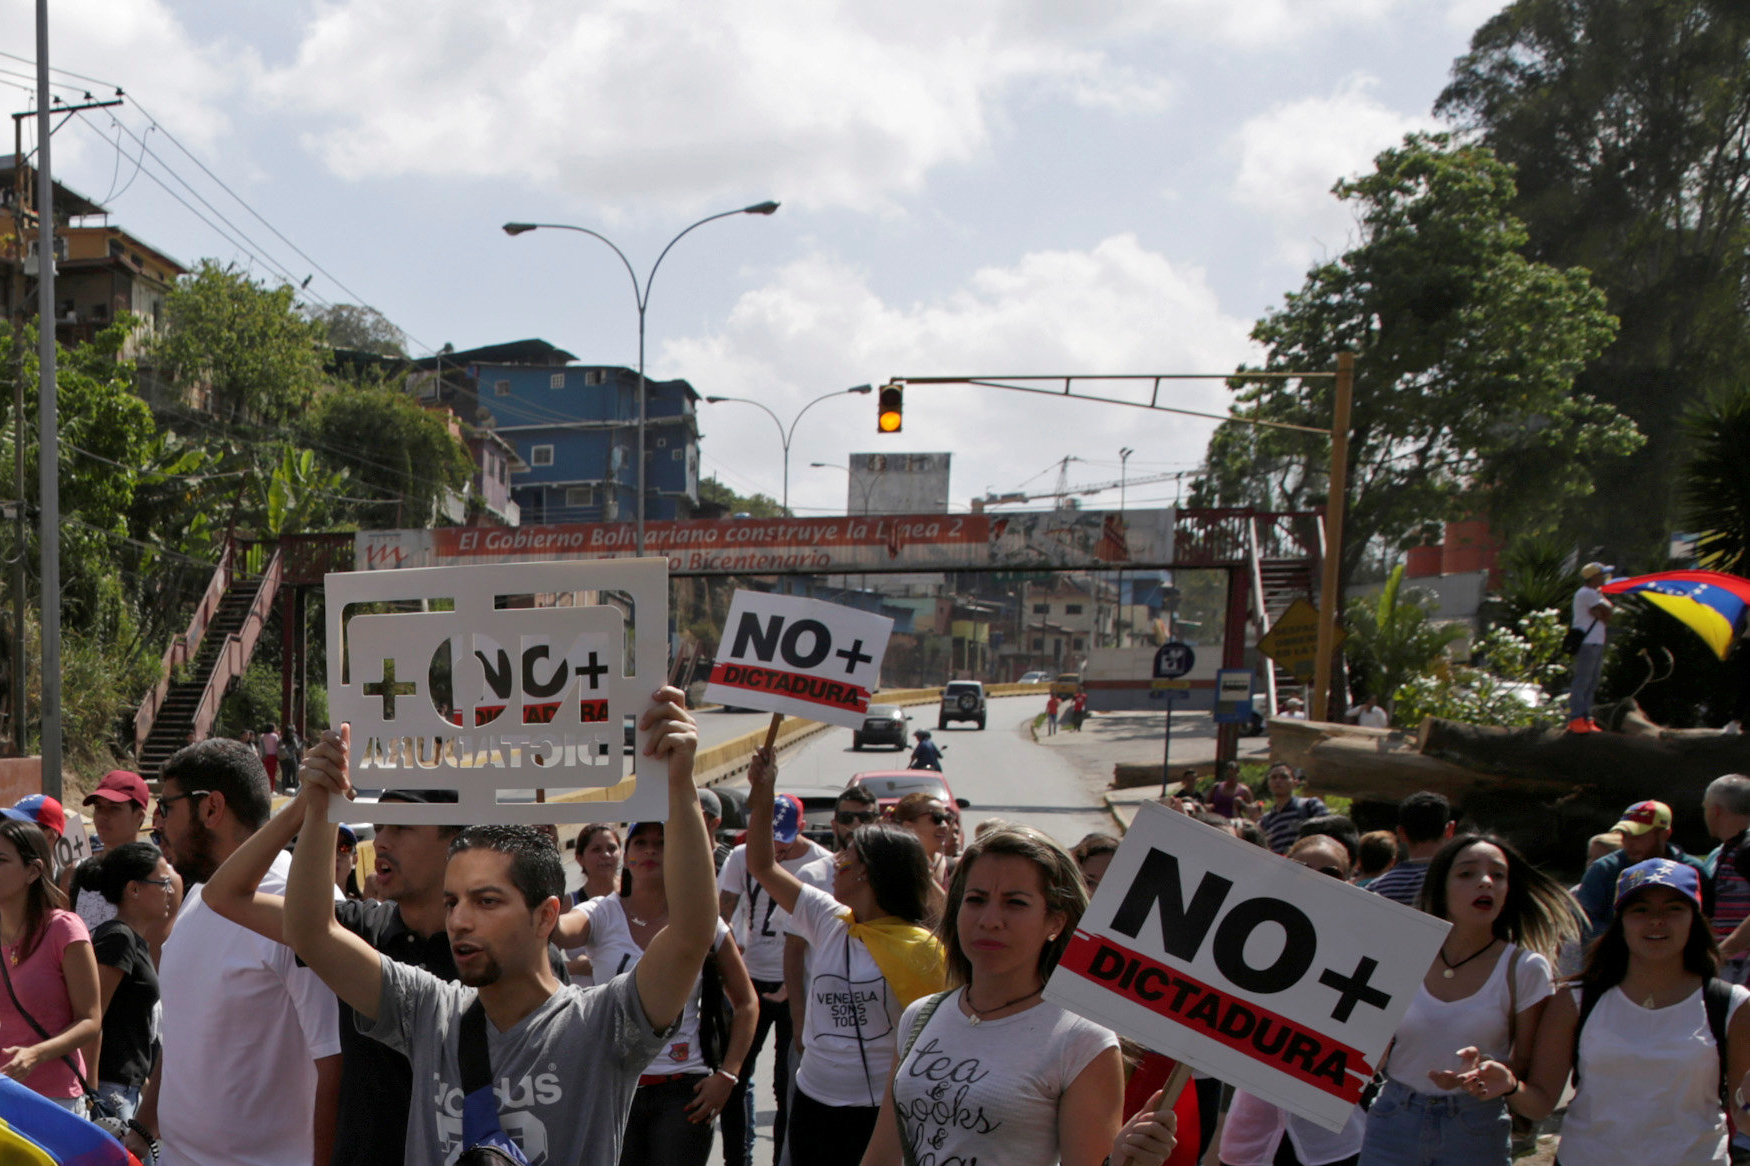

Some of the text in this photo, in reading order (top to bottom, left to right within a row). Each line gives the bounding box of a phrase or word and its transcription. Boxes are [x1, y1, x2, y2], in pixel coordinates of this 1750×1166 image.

[458, 531, 478, 551] El
[485, 529, 583, 549] Gobierno
[591, 523, 718, 546] Bolivariano
[725, 521, 838, 545] construye
[846, 519, 868, 540] la
[948, 518, 963, 537] 2
[688, 549, 831, 572] Bicentenario
[723, 666, 860, 707] DICTADURA
[1109, 846, 1392, 1024] NO+
[816, 990, 879, 1006] VENEELA
[831, 1003, 867, 1017] SOMS
[832, 1014, 868, 1028] TODS
[1086, 944, 1350, 1088] DICTADURA
[909, 1038, 989, 1084] tea
